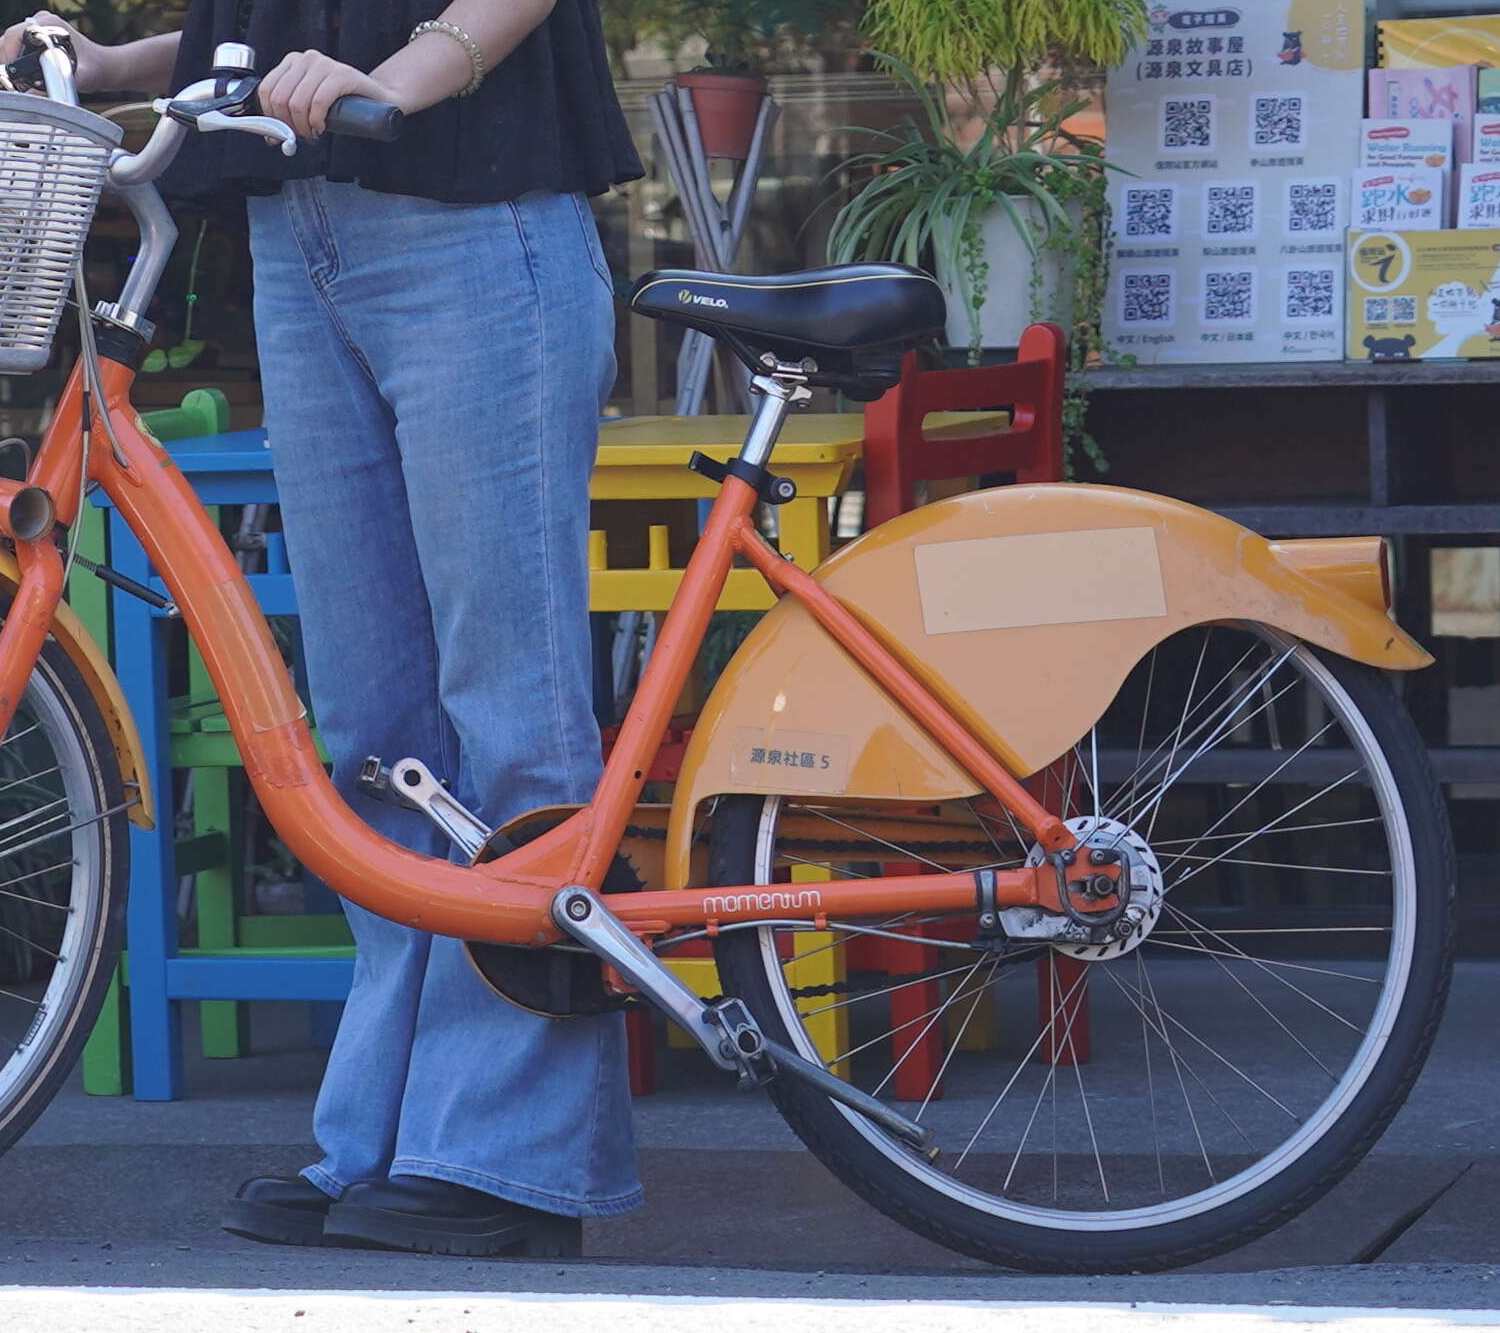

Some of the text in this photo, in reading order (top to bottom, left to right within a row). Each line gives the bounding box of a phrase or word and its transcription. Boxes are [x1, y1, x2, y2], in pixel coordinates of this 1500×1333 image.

[1146, 36, 1245, 57] 源泉故事屋
[1136, 58, 1254, 81] (源泉文具店)
[1367, 143, 1447, 153] Water Running
[693, 295, 727, 308] VELO
[1142, 334, 1175, 345] English
[750, 747, 830, 769] 源泉社區 5
[703, 890, 821, 914] momentum
